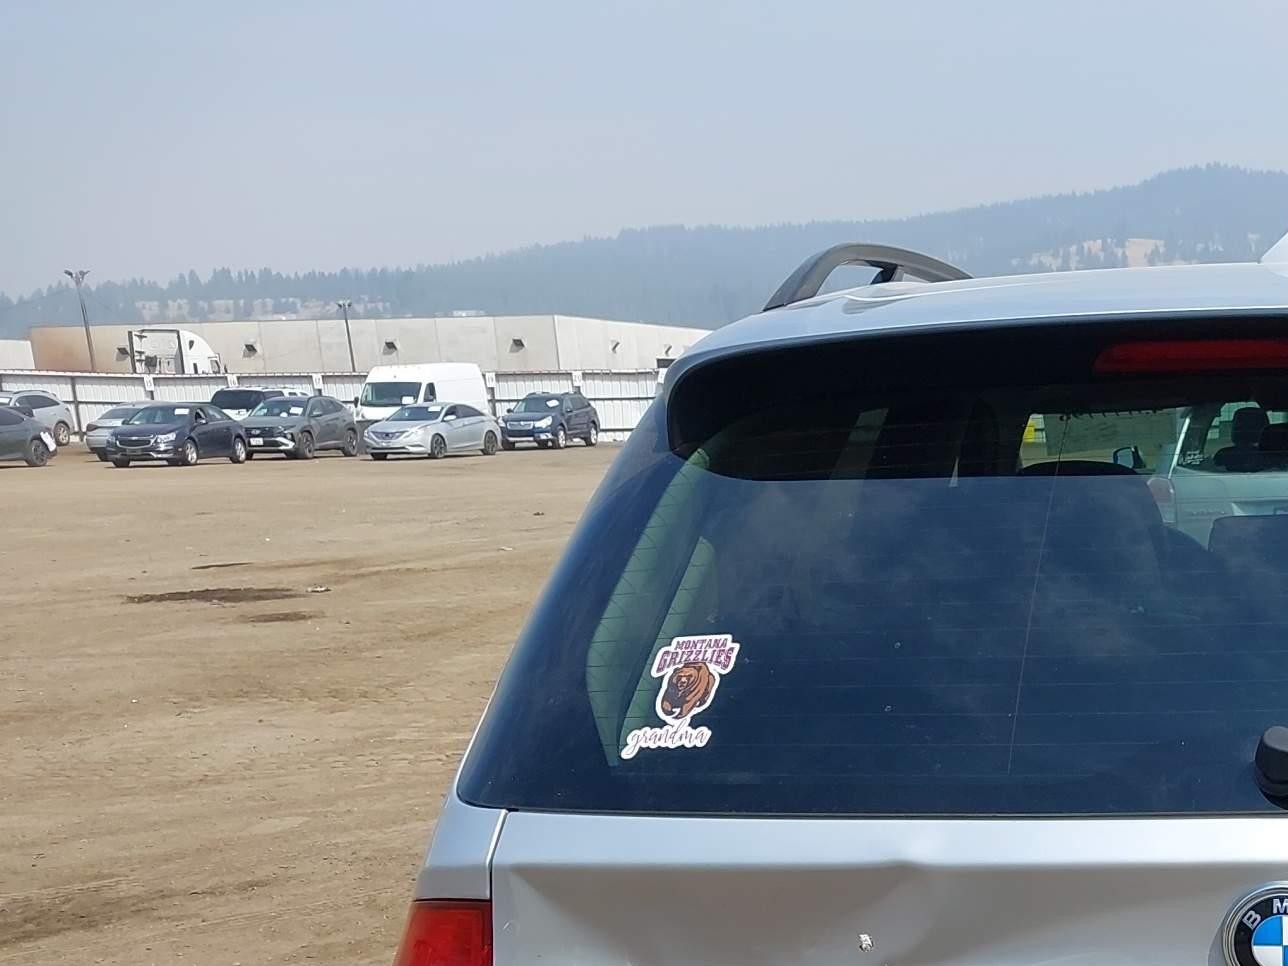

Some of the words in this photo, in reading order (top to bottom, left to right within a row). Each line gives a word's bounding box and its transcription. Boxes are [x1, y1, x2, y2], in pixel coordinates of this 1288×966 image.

[674, 638, 729, 650] MONTANA
[656, 647, 735, 673] GRIZZLIES
[625, 719, 707, 756] grandma
